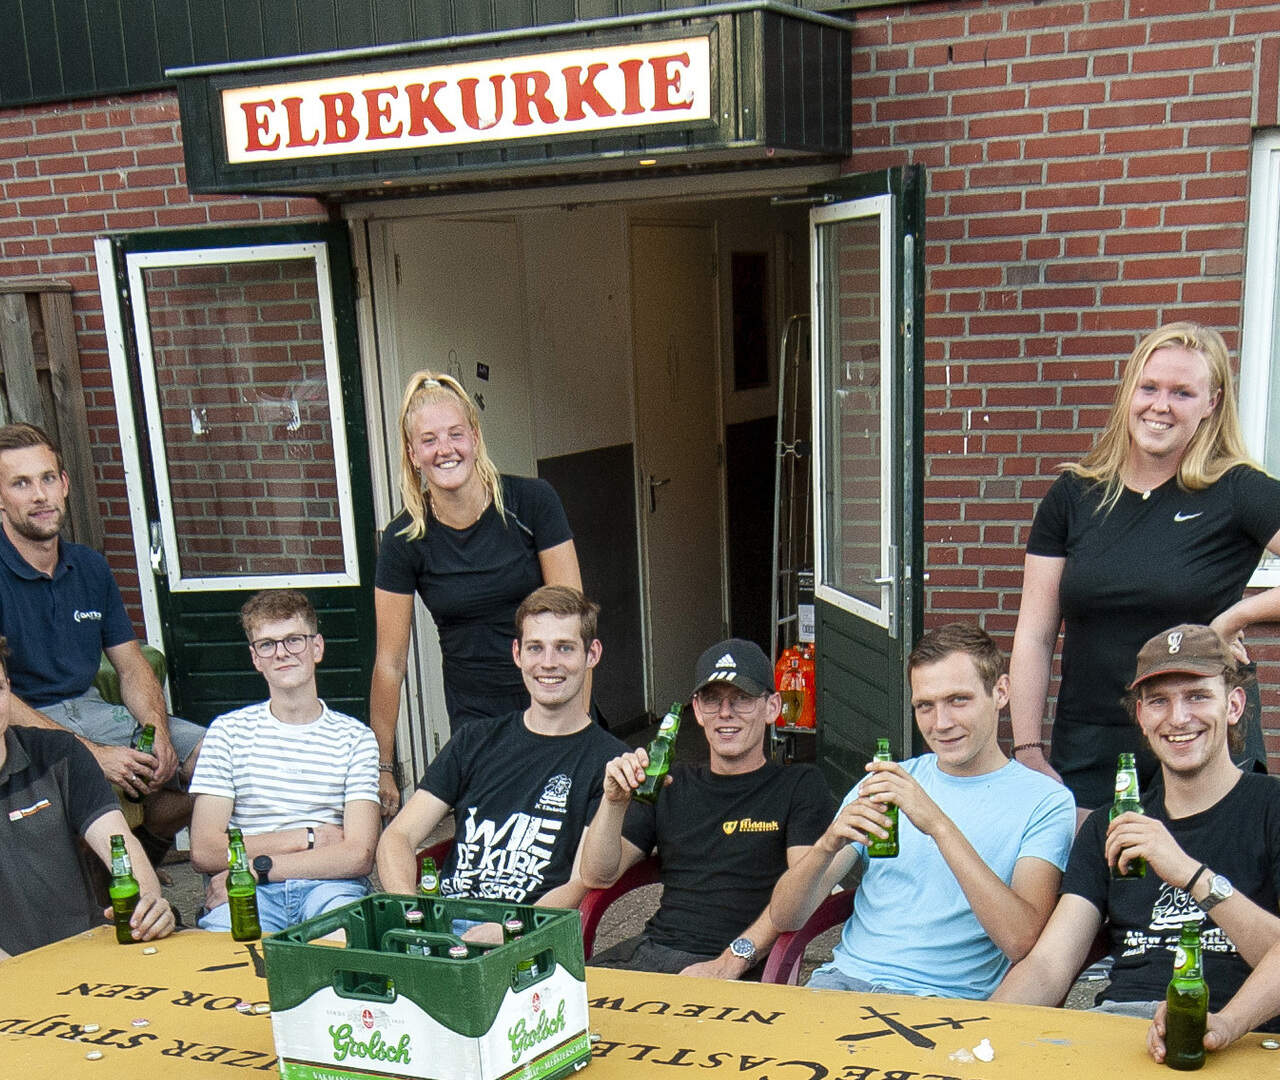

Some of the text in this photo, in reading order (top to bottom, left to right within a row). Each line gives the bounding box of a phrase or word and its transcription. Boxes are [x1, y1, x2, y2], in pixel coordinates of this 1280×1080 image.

[239, 51, 694, 152] ELBEKURKIE
[465, 807, 562, 860] WIE
[457, 843, 551, 880] DE KURK
[57, 983, 168, 1001] EEN
[328, 1024, 411, 1064] Grolsch
[508, 998, 566, 1064] Grolsch
